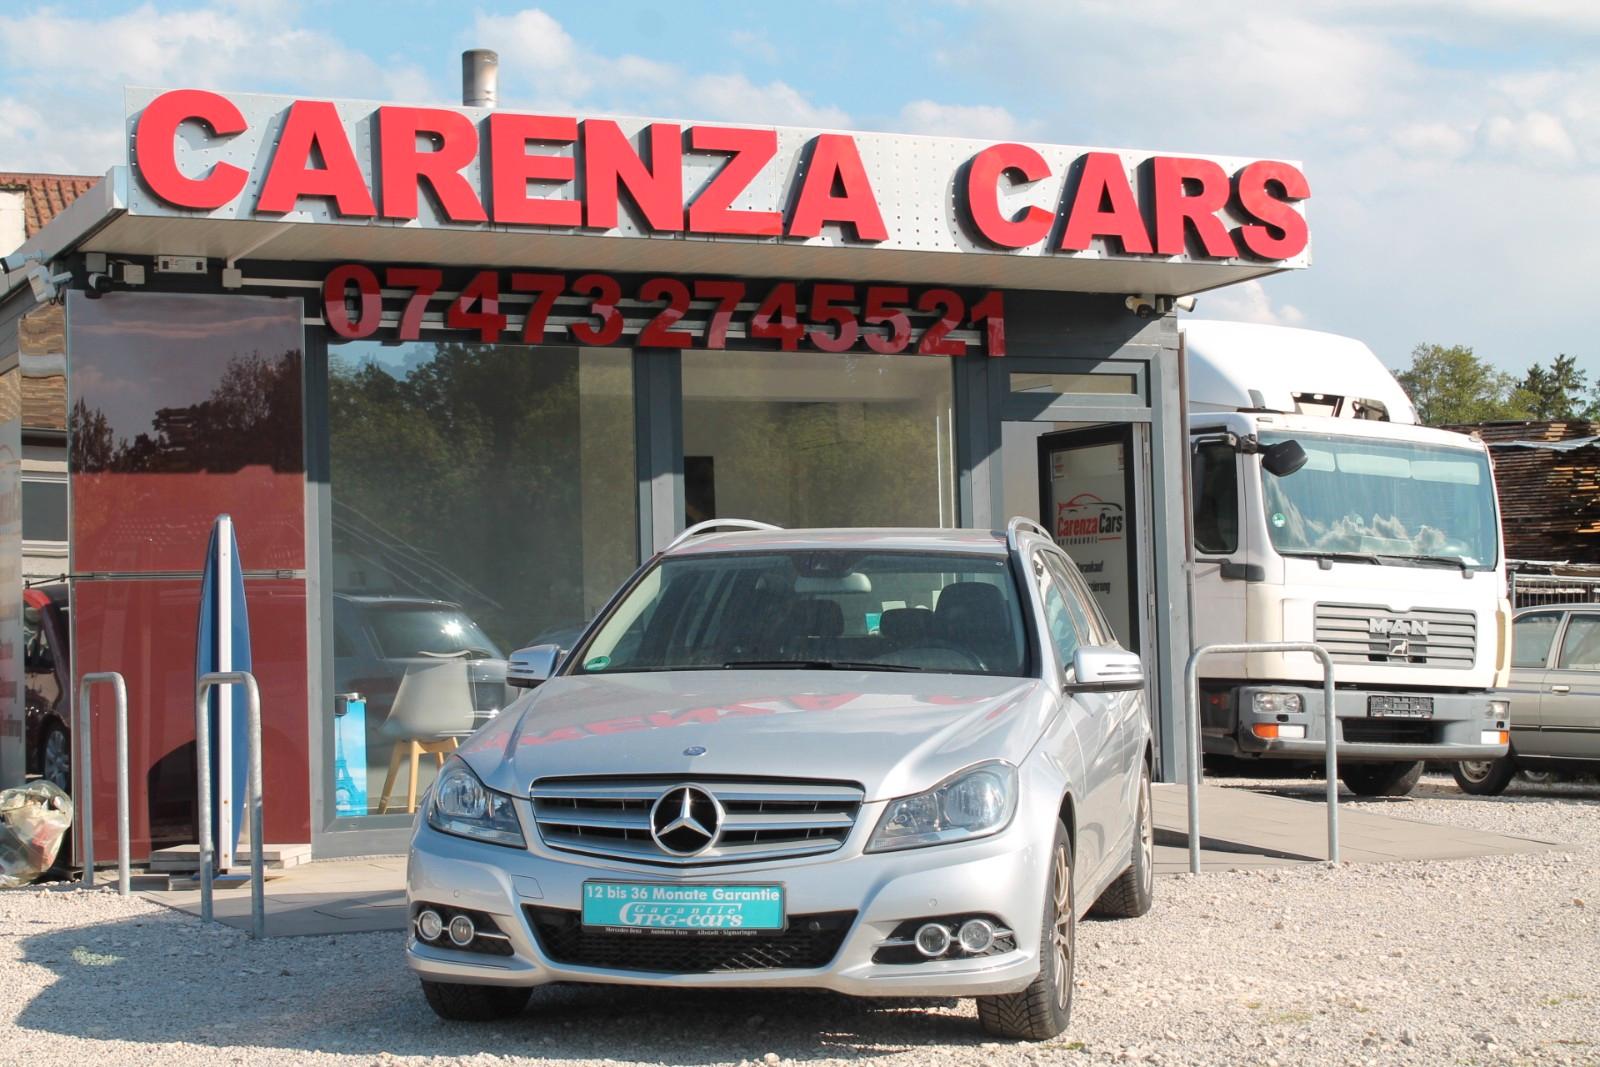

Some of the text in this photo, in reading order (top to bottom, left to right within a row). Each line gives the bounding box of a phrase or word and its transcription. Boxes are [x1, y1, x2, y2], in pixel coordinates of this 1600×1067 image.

[133, 88, 1310, 260] CARENZA CARS
[1057, 513, 1122, 537] Carenza Cars
[1369, 618, 1428, 635] MAN
[586, 885, 780, 901] 12 bis 36 Monate Garantie
[634, 904, 736, 915] Garantie
